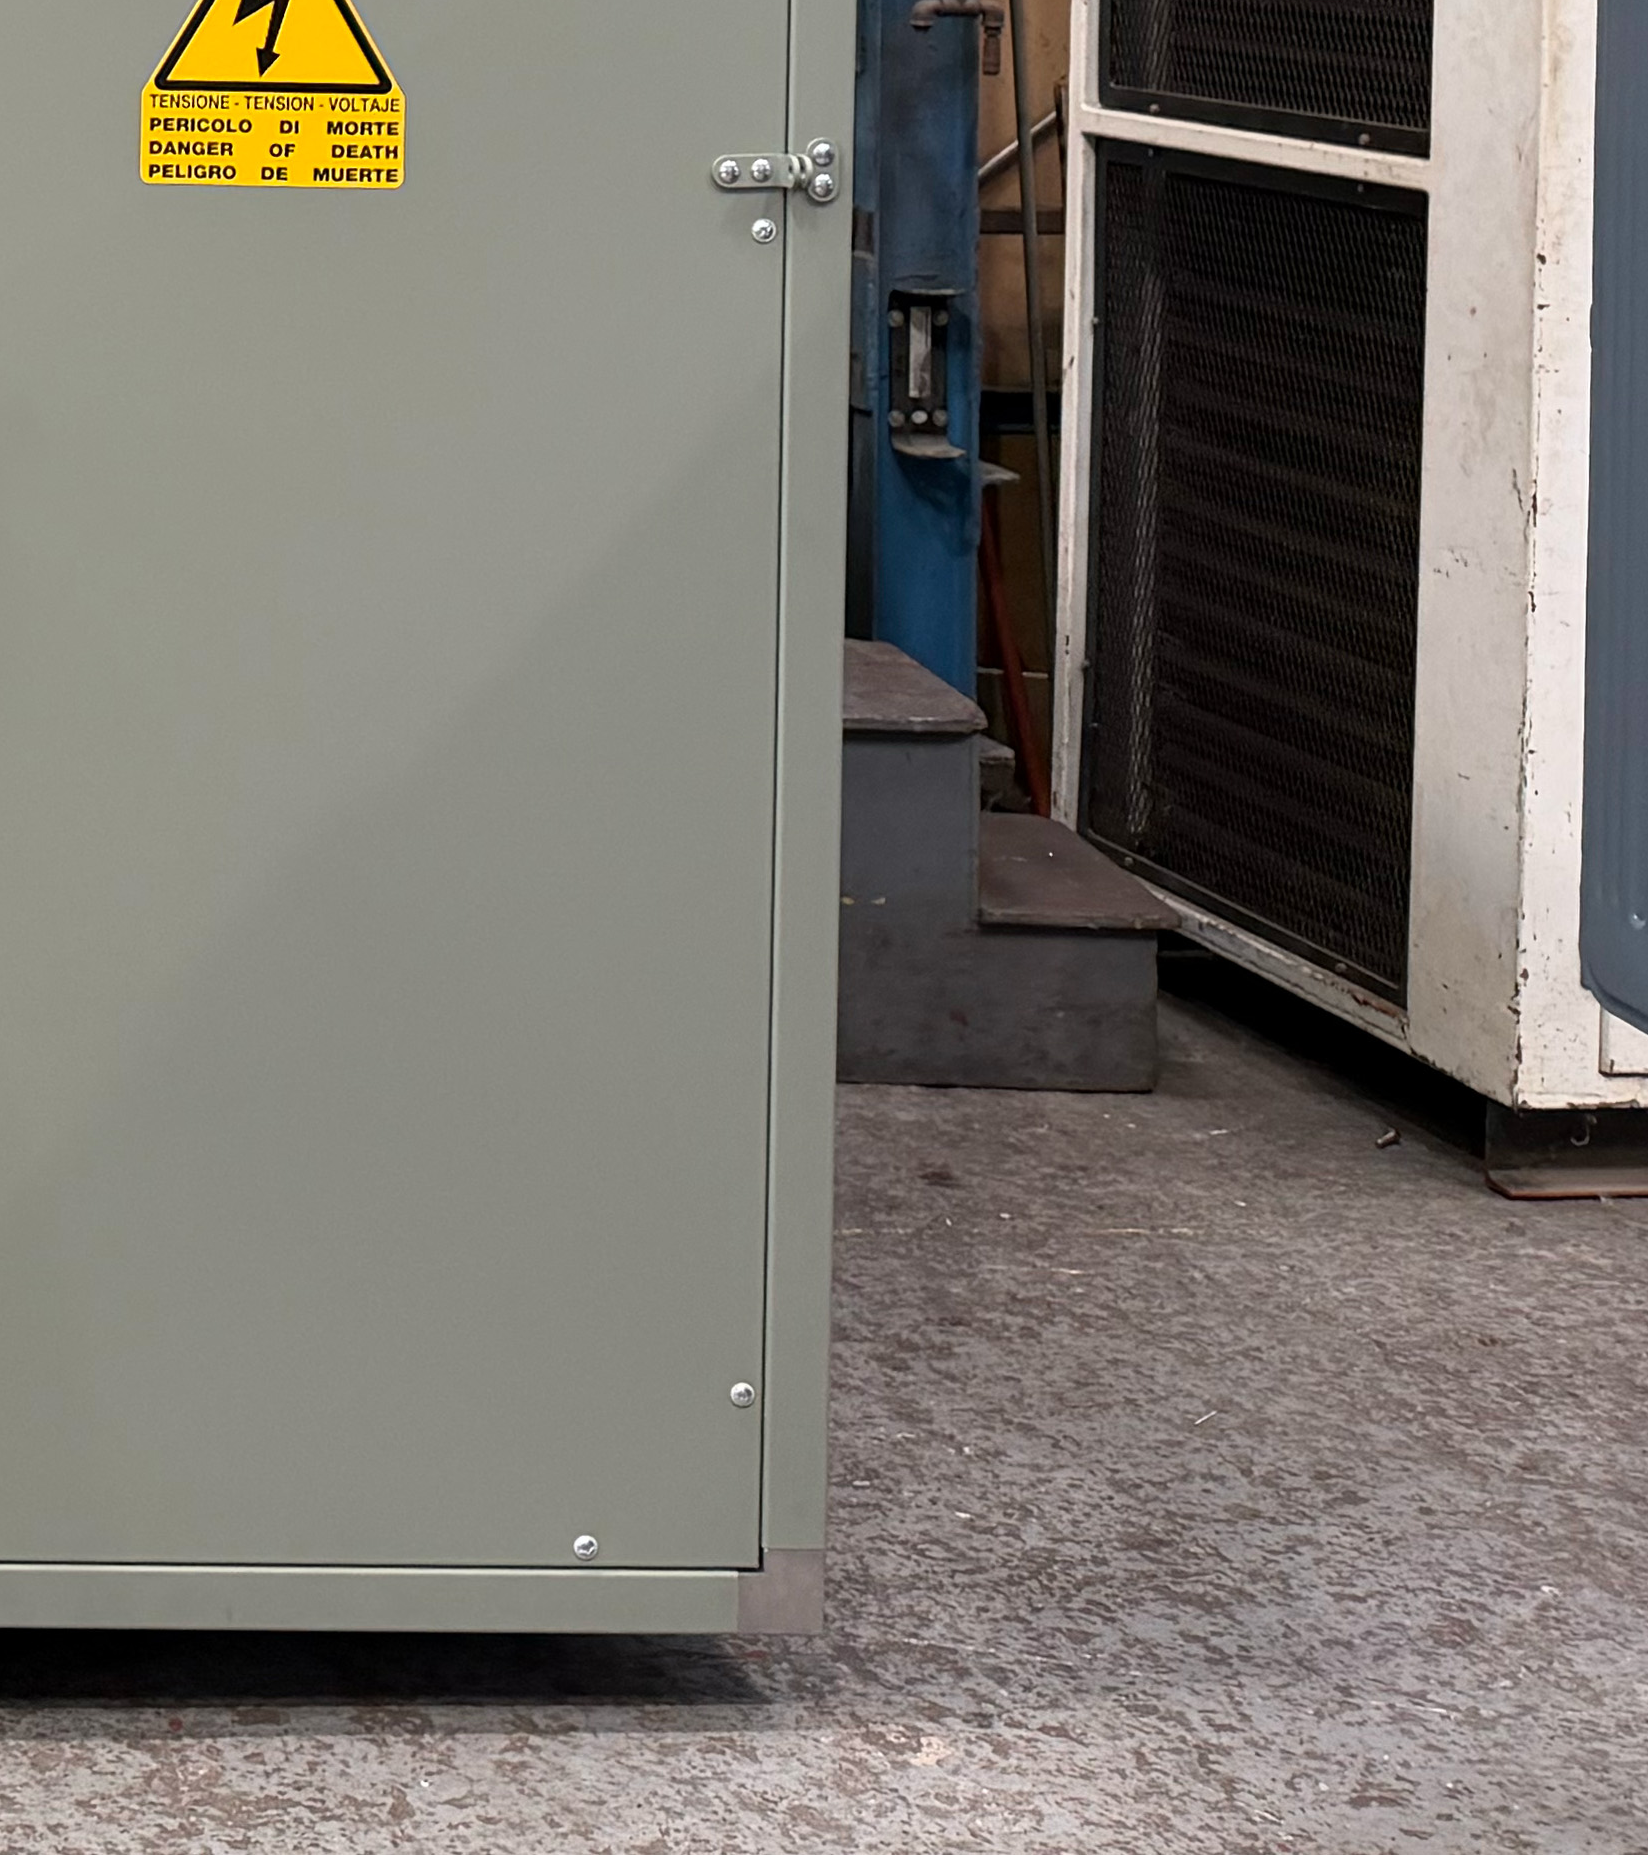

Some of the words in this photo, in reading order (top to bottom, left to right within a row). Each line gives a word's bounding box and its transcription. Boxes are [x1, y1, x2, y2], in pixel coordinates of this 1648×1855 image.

[150, 94, 230, 109] TENSIONE
[245, 96, 314, 111] TENSION
[329, 97, 400, 112] VOLTAJE
[150, 118, 252, 133] PERICOLO
[280, 120, 299, 134] DI
[327, 121, 399, 135] MORTE
[149, 141, 233, 156] DANGER
[269, 143, 296, 157] OF
[332, 145, 398, 159] DEATH
[149, 164, 236, 179] PELIGRO
[261, 166, 288, 180] DE
[313, 167, 398, 182] MUERTE
